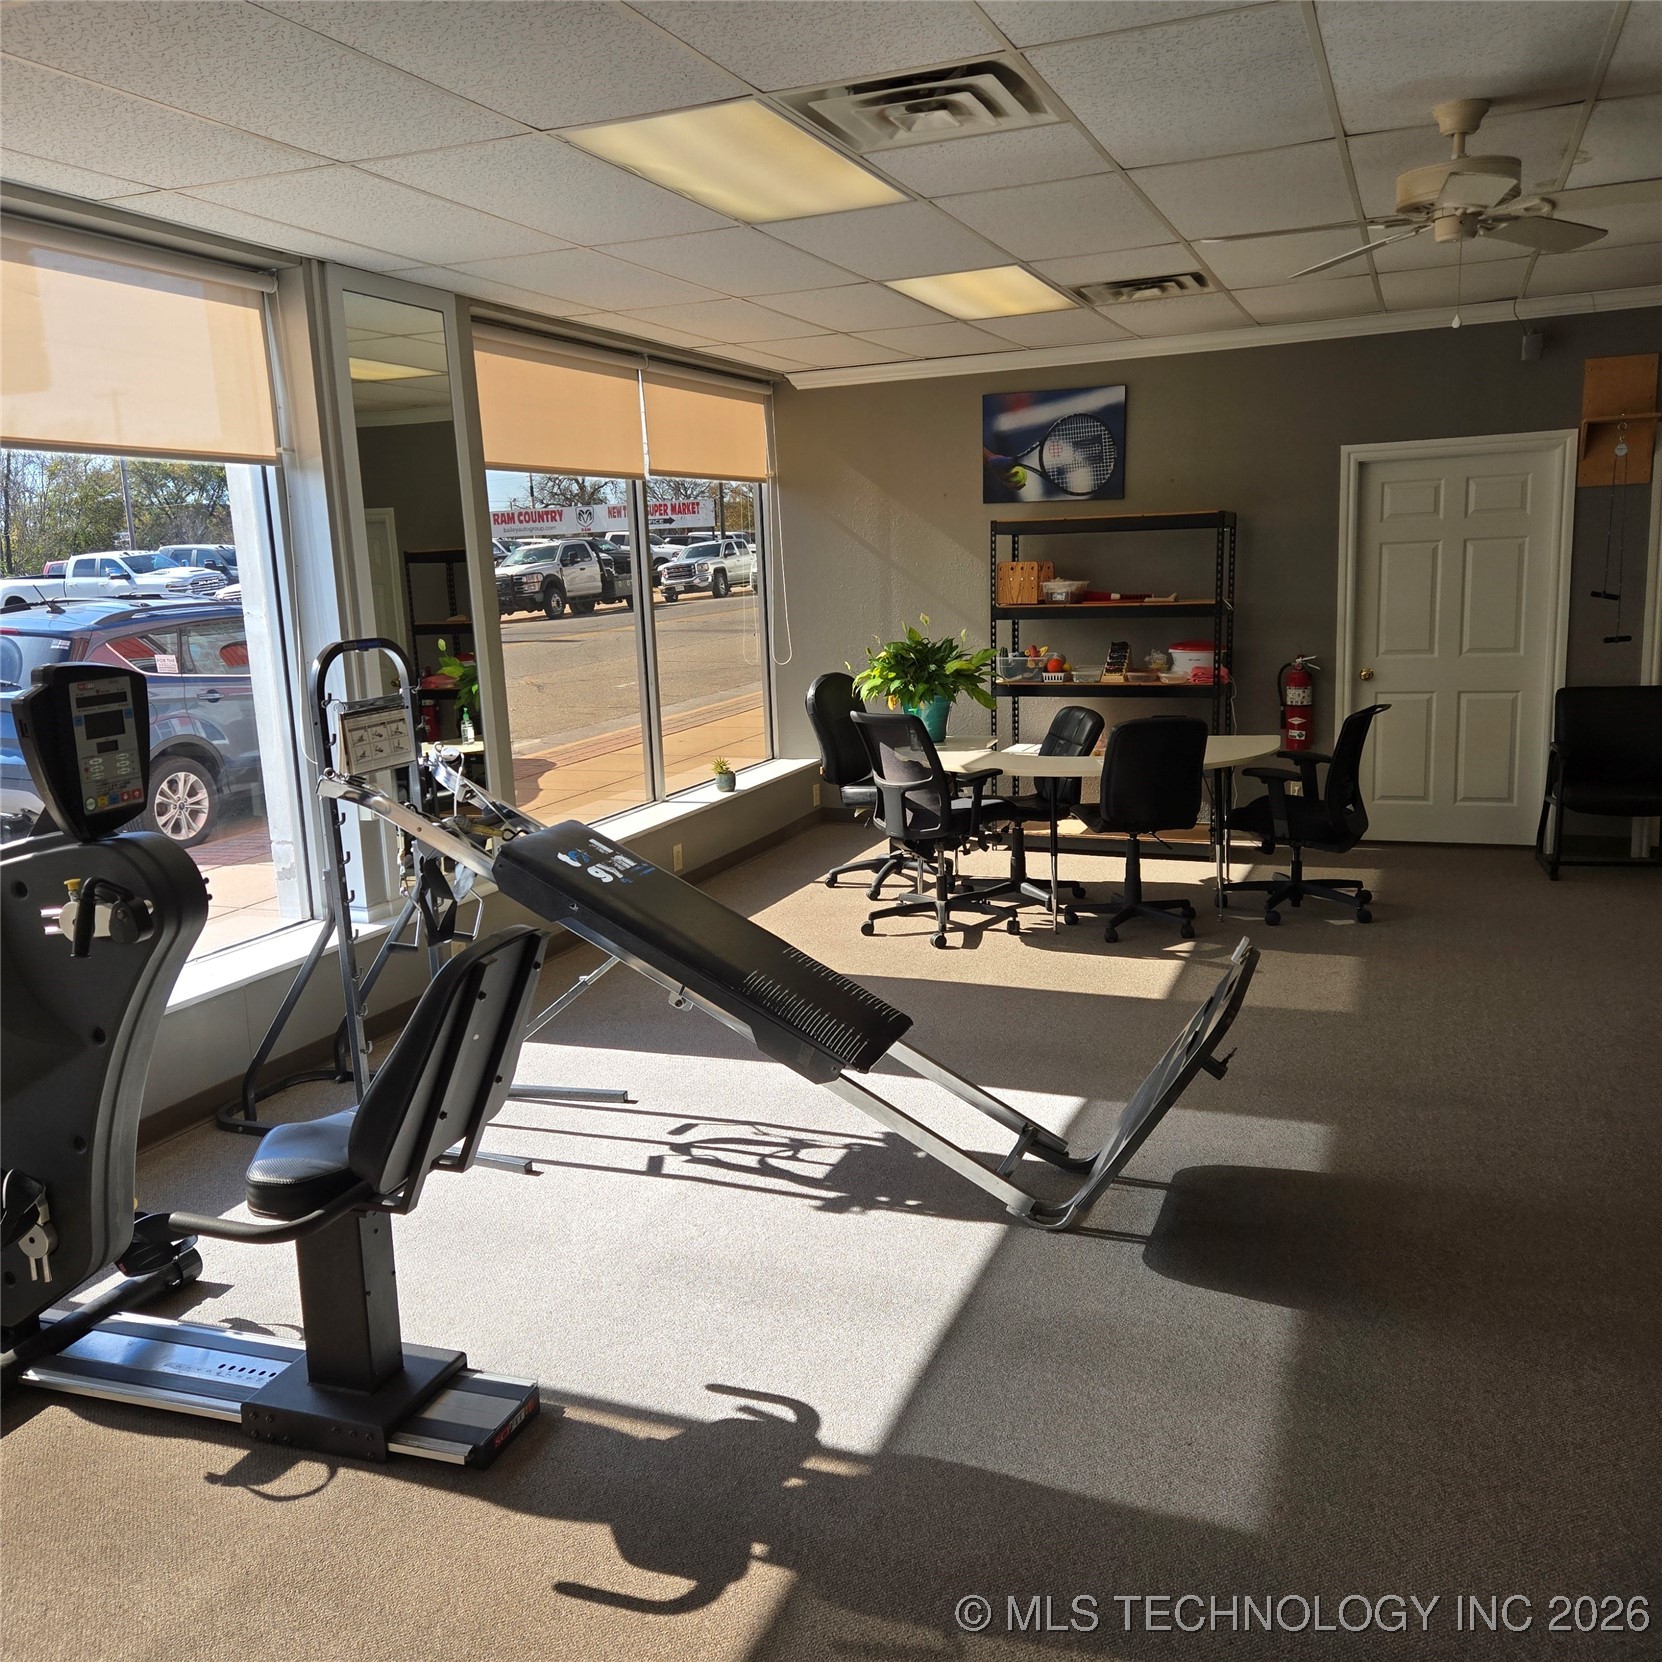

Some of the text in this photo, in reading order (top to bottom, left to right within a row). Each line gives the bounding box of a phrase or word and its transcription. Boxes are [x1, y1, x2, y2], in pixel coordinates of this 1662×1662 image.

[492, 509, 564, 526] RAM COUNTRY
[608, 506, 620, 519] NEW
[671, 501, 700, 515] MARKET
[503, 525, 557, 534] baileyautogroup.com
